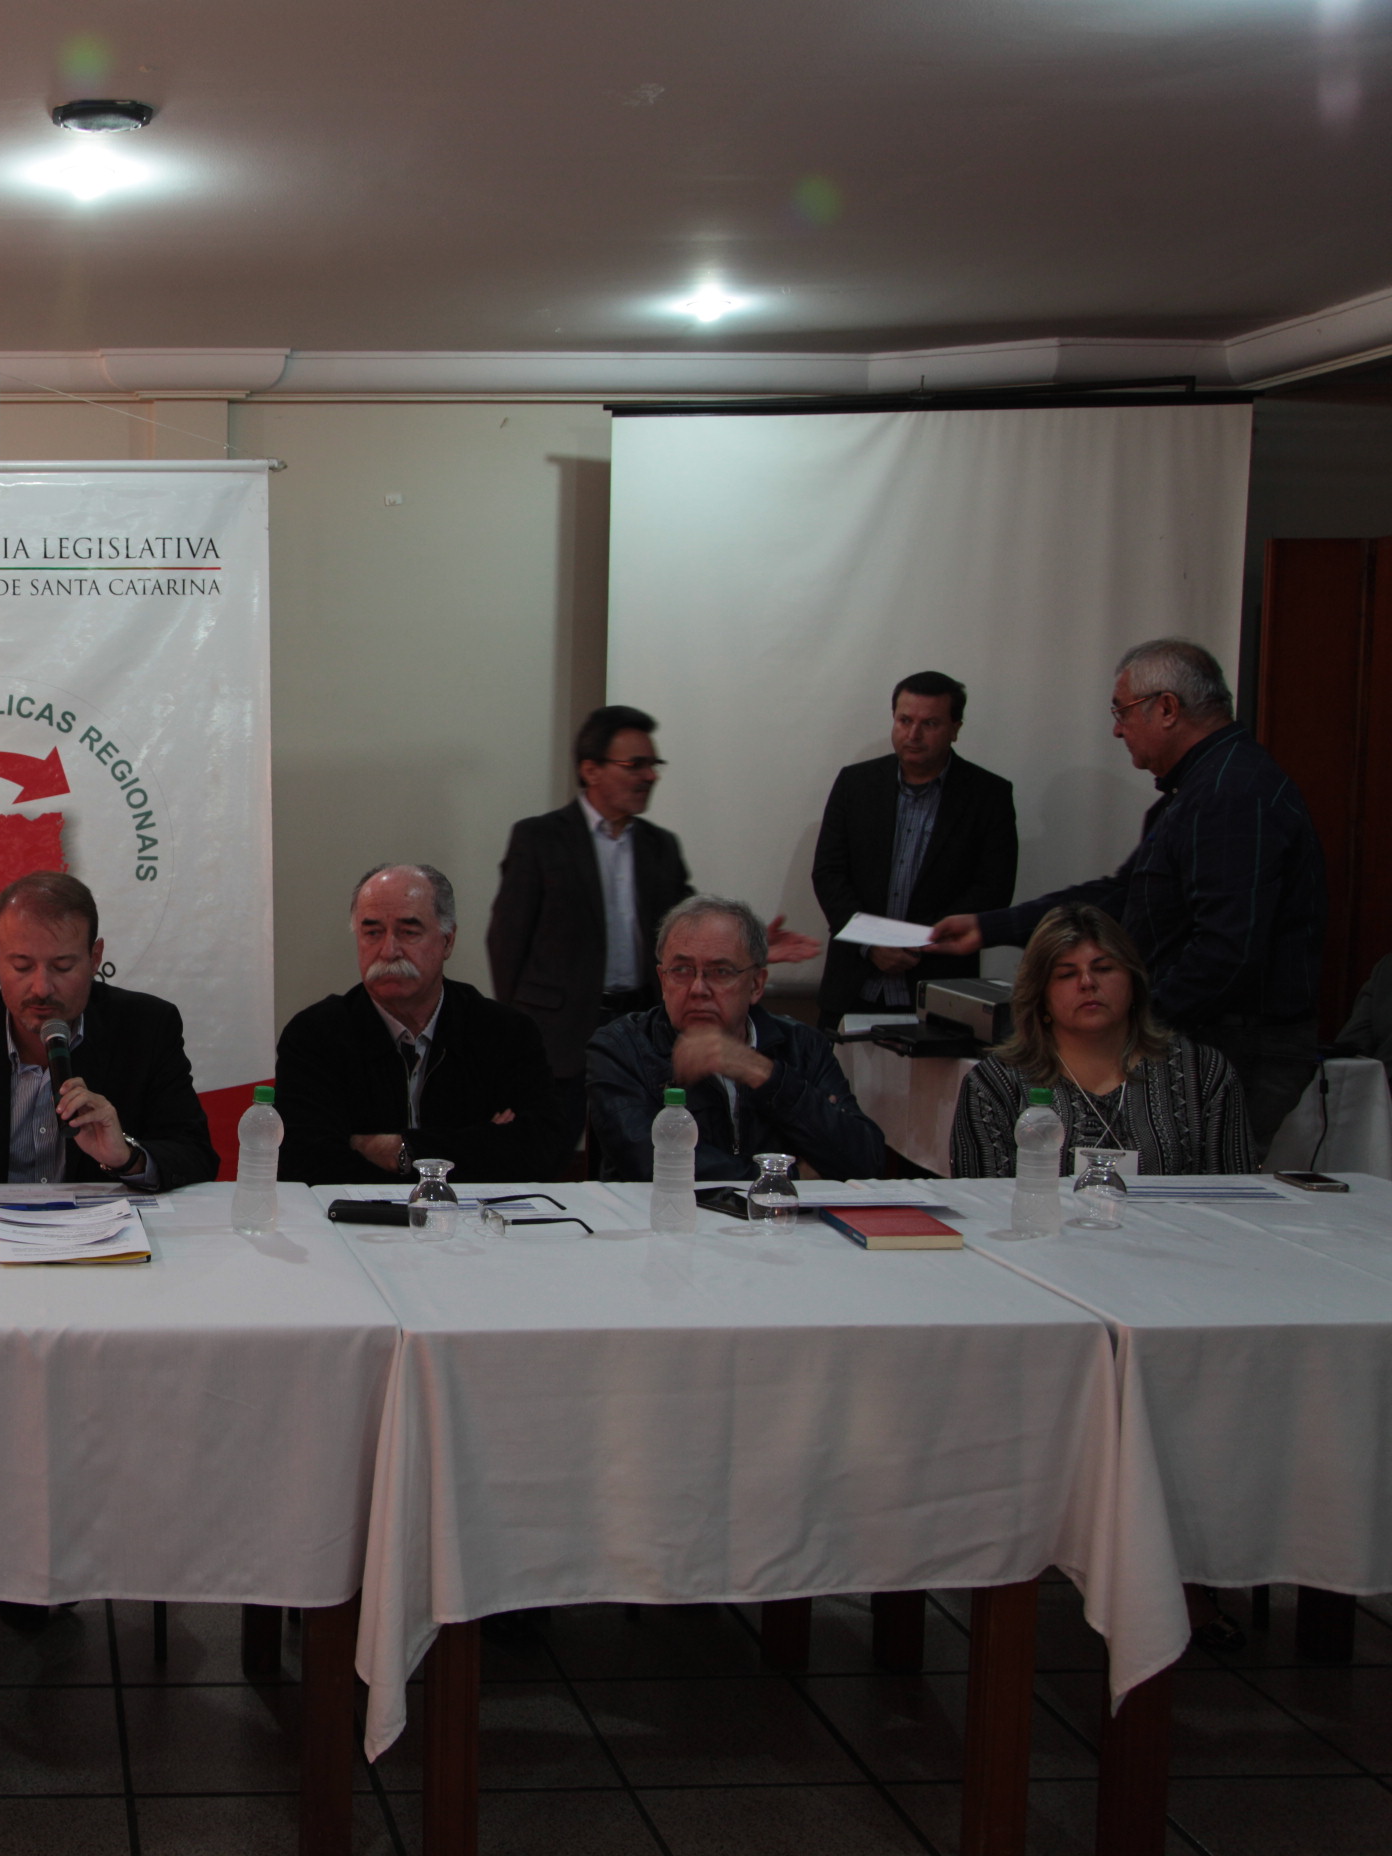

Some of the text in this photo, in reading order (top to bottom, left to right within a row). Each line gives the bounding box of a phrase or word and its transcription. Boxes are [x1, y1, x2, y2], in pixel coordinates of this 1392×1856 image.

[42, 537, 221, 560] LEGISLATIVA
[30, 578, 102, 596] SANTA
[108, 578, 221, 596] CATARINA
[78, 725, 159, 882] REGIONAIS
